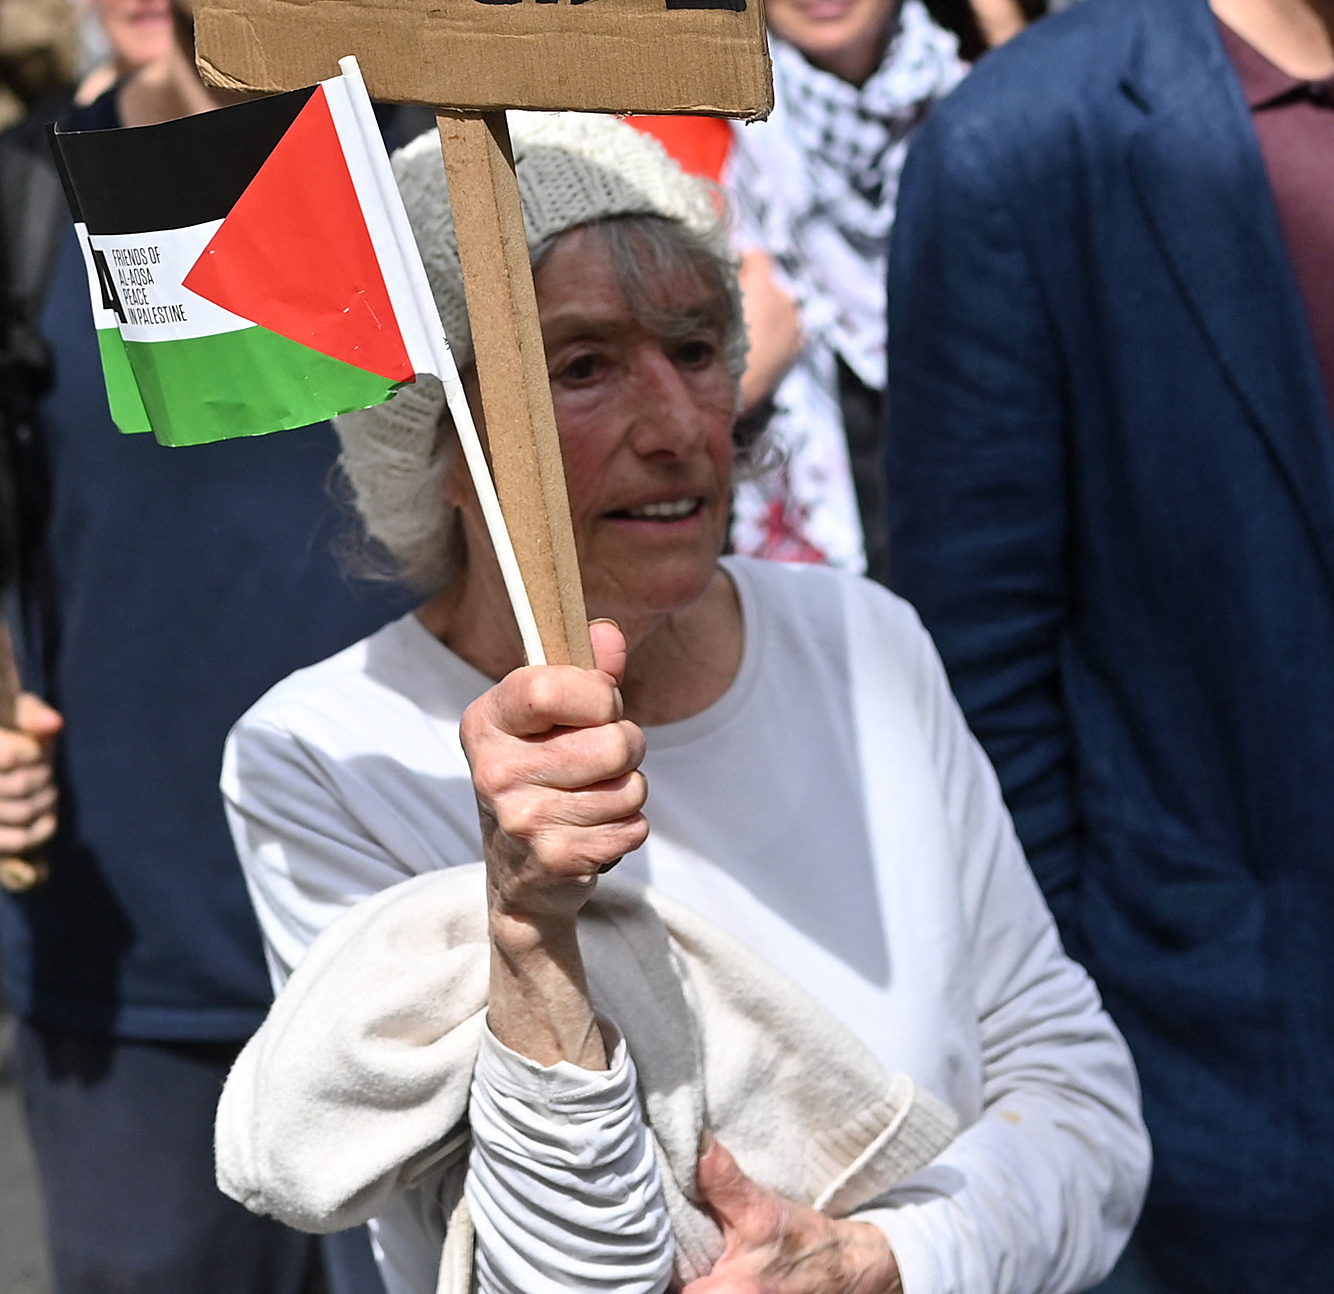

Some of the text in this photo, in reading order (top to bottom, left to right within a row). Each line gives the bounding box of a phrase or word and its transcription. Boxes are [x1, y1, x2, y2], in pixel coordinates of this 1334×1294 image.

[111, 245, 161, 267] FRIENDS OF
[117, 267, 155, 287] AL-AQSA
[122, 287, 150, 307] PEACE
[127, 304, 187, 325] IN PALESTINE
